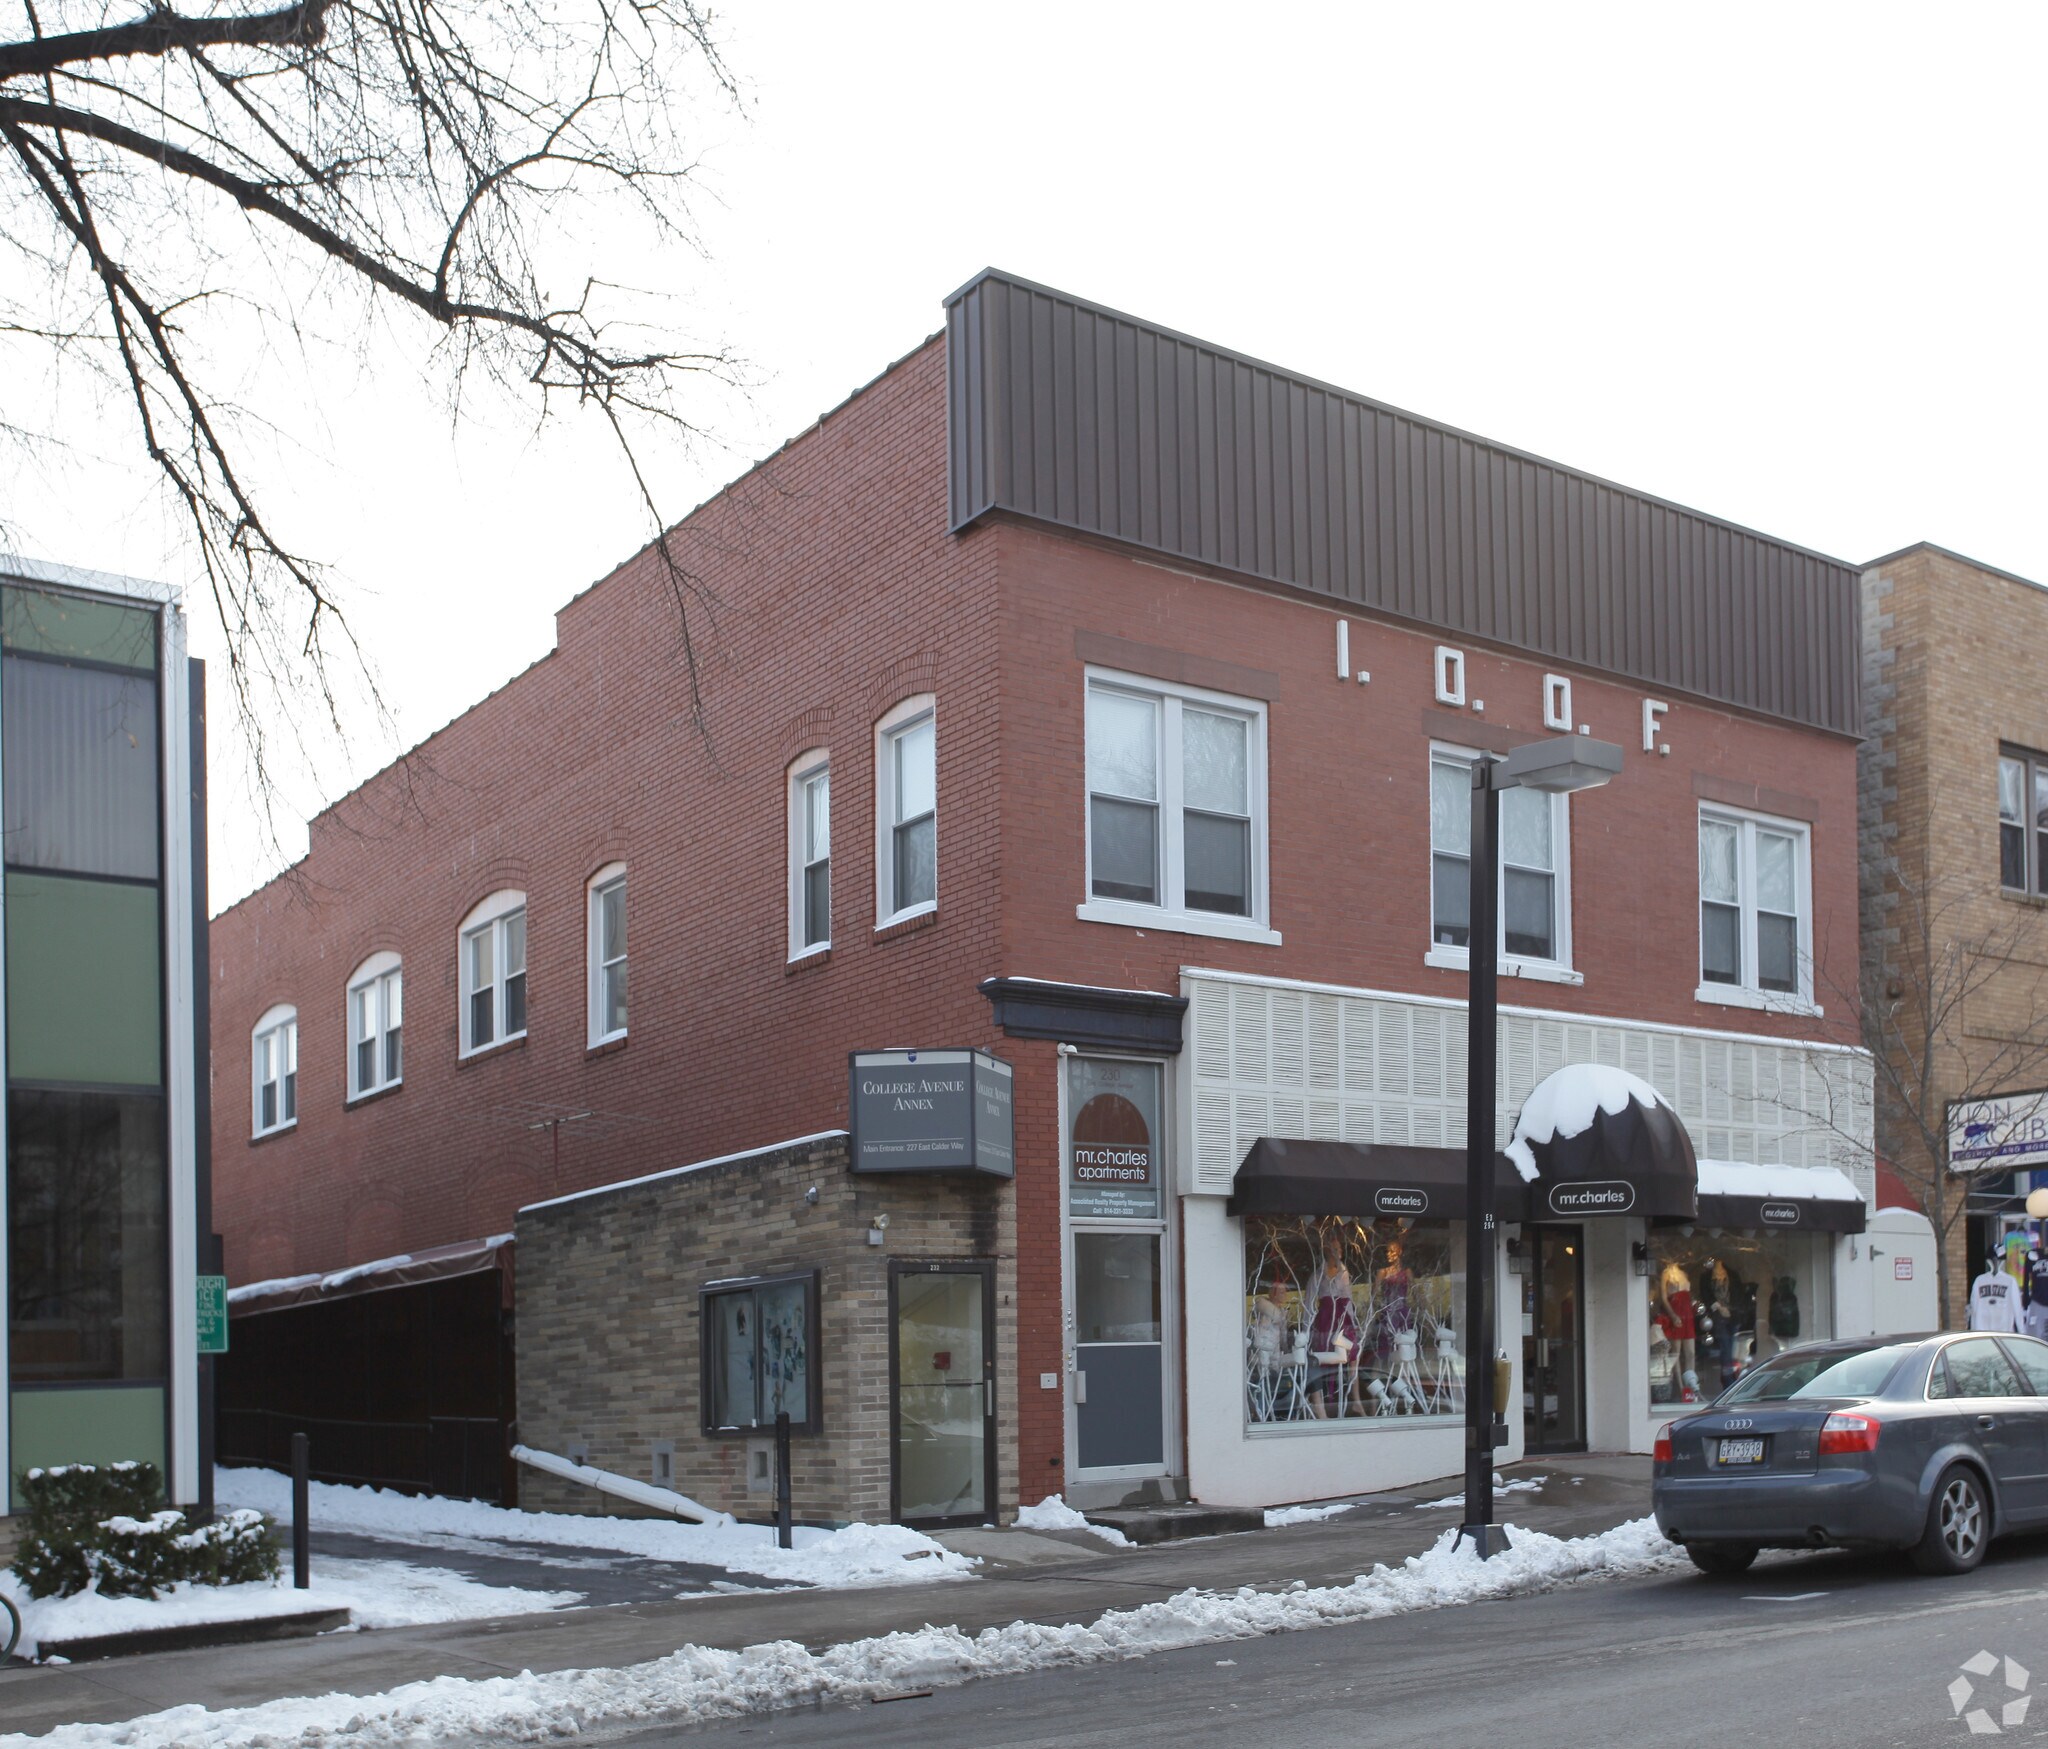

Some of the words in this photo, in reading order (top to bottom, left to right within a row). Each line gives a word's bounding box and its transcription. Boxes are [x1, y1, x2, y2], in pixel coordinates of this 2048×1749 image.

[862, 1080, 916, 1095] COLLEGE
[918, 1079, 965, 1093] AVENUE
[893, 1097, 934, 1111] ANNEX
[863, 1144, 879, 1153] Main
[906, 1143, 918, 1152] 227
[918, 1143, 931, 1151] East
[951, 1142, 965, 1151] Way
[1076, 1148, 1148, 1166] mr.charles
[1078, 1165, 1146, 1181] apartments
[1381, 1194, 1422, 1206] mr.charles
[1559, 1189, 1625, 1205] mr.charles
